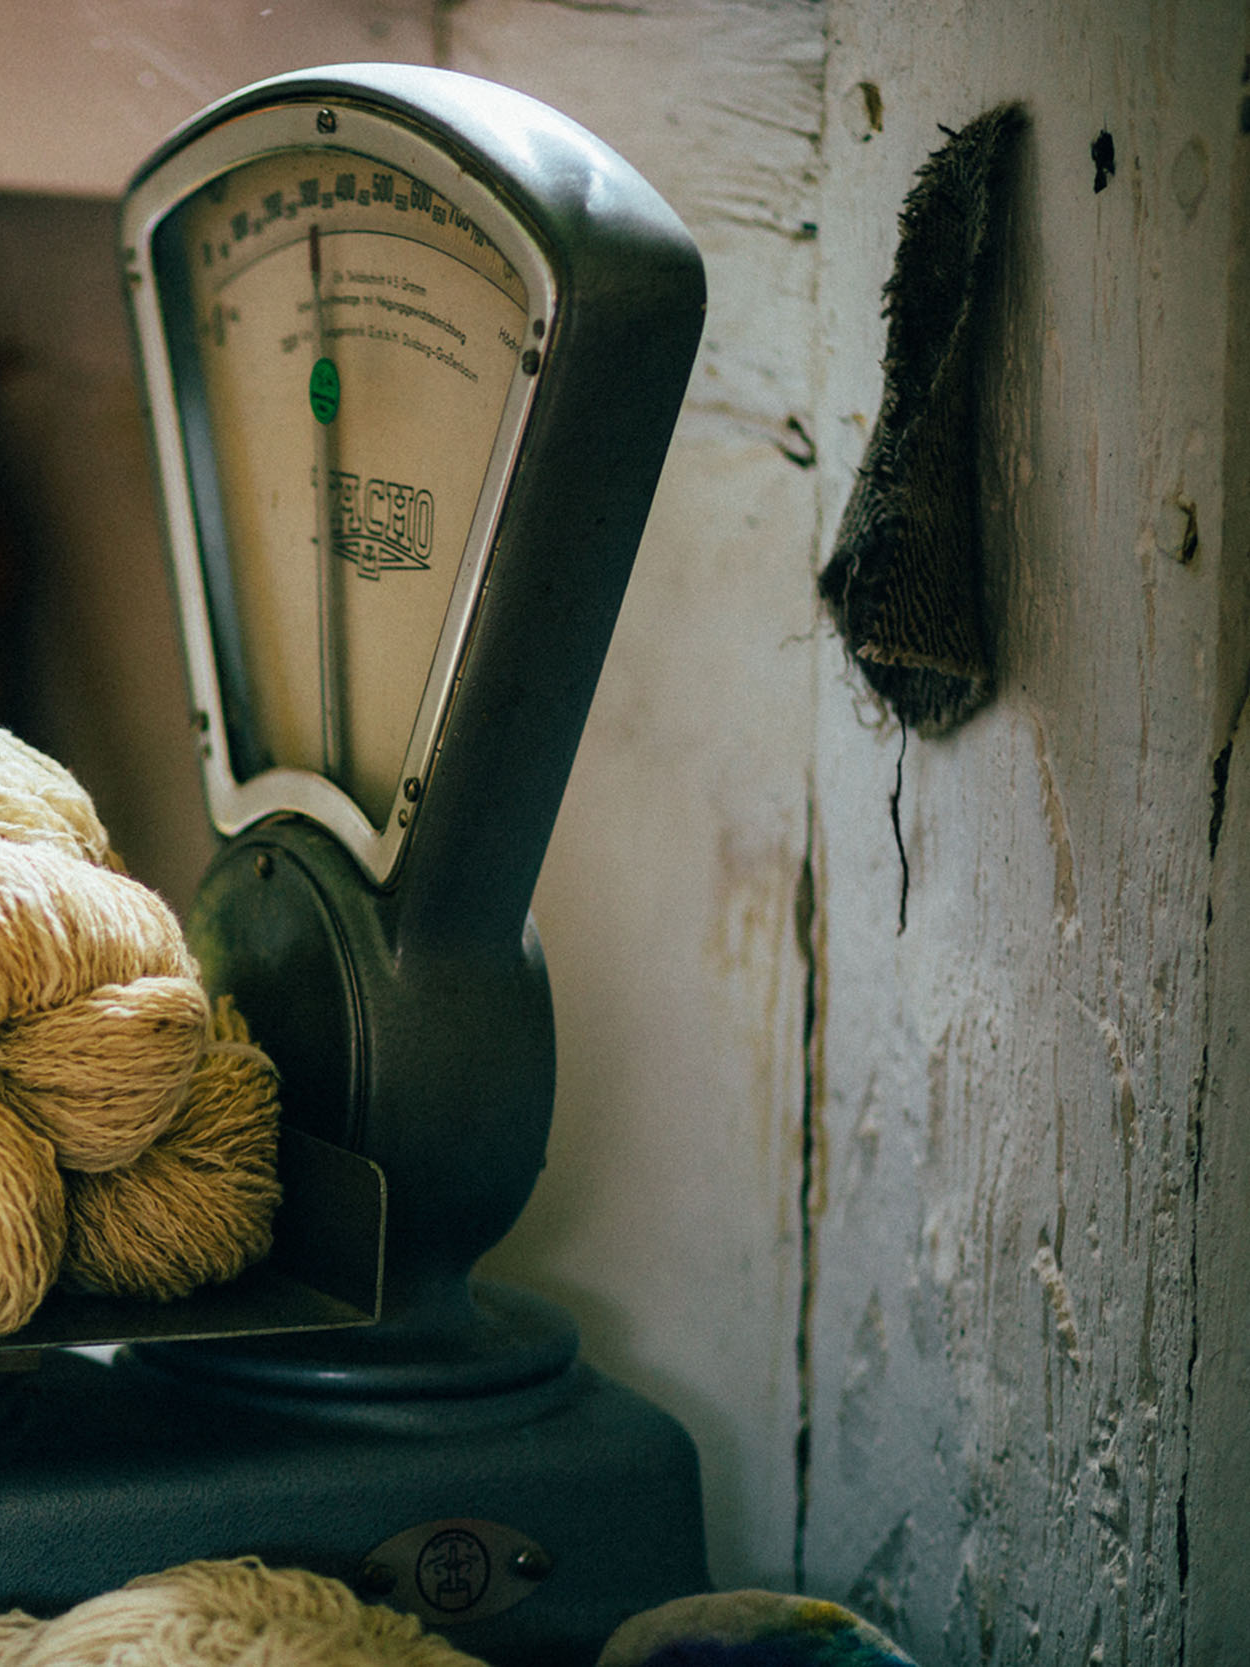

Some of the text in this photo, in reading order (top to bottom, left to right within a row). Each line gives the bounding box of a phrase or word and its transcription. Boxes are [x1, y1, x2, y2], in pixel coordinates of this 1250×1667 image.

[372, 173, 393, 202] 500
[410, 178, 432, 213] 600
[431, 204, 446, 225] 650
[449, 207, 470, 232] 700
[401, 276, 427, 296] Gramm
